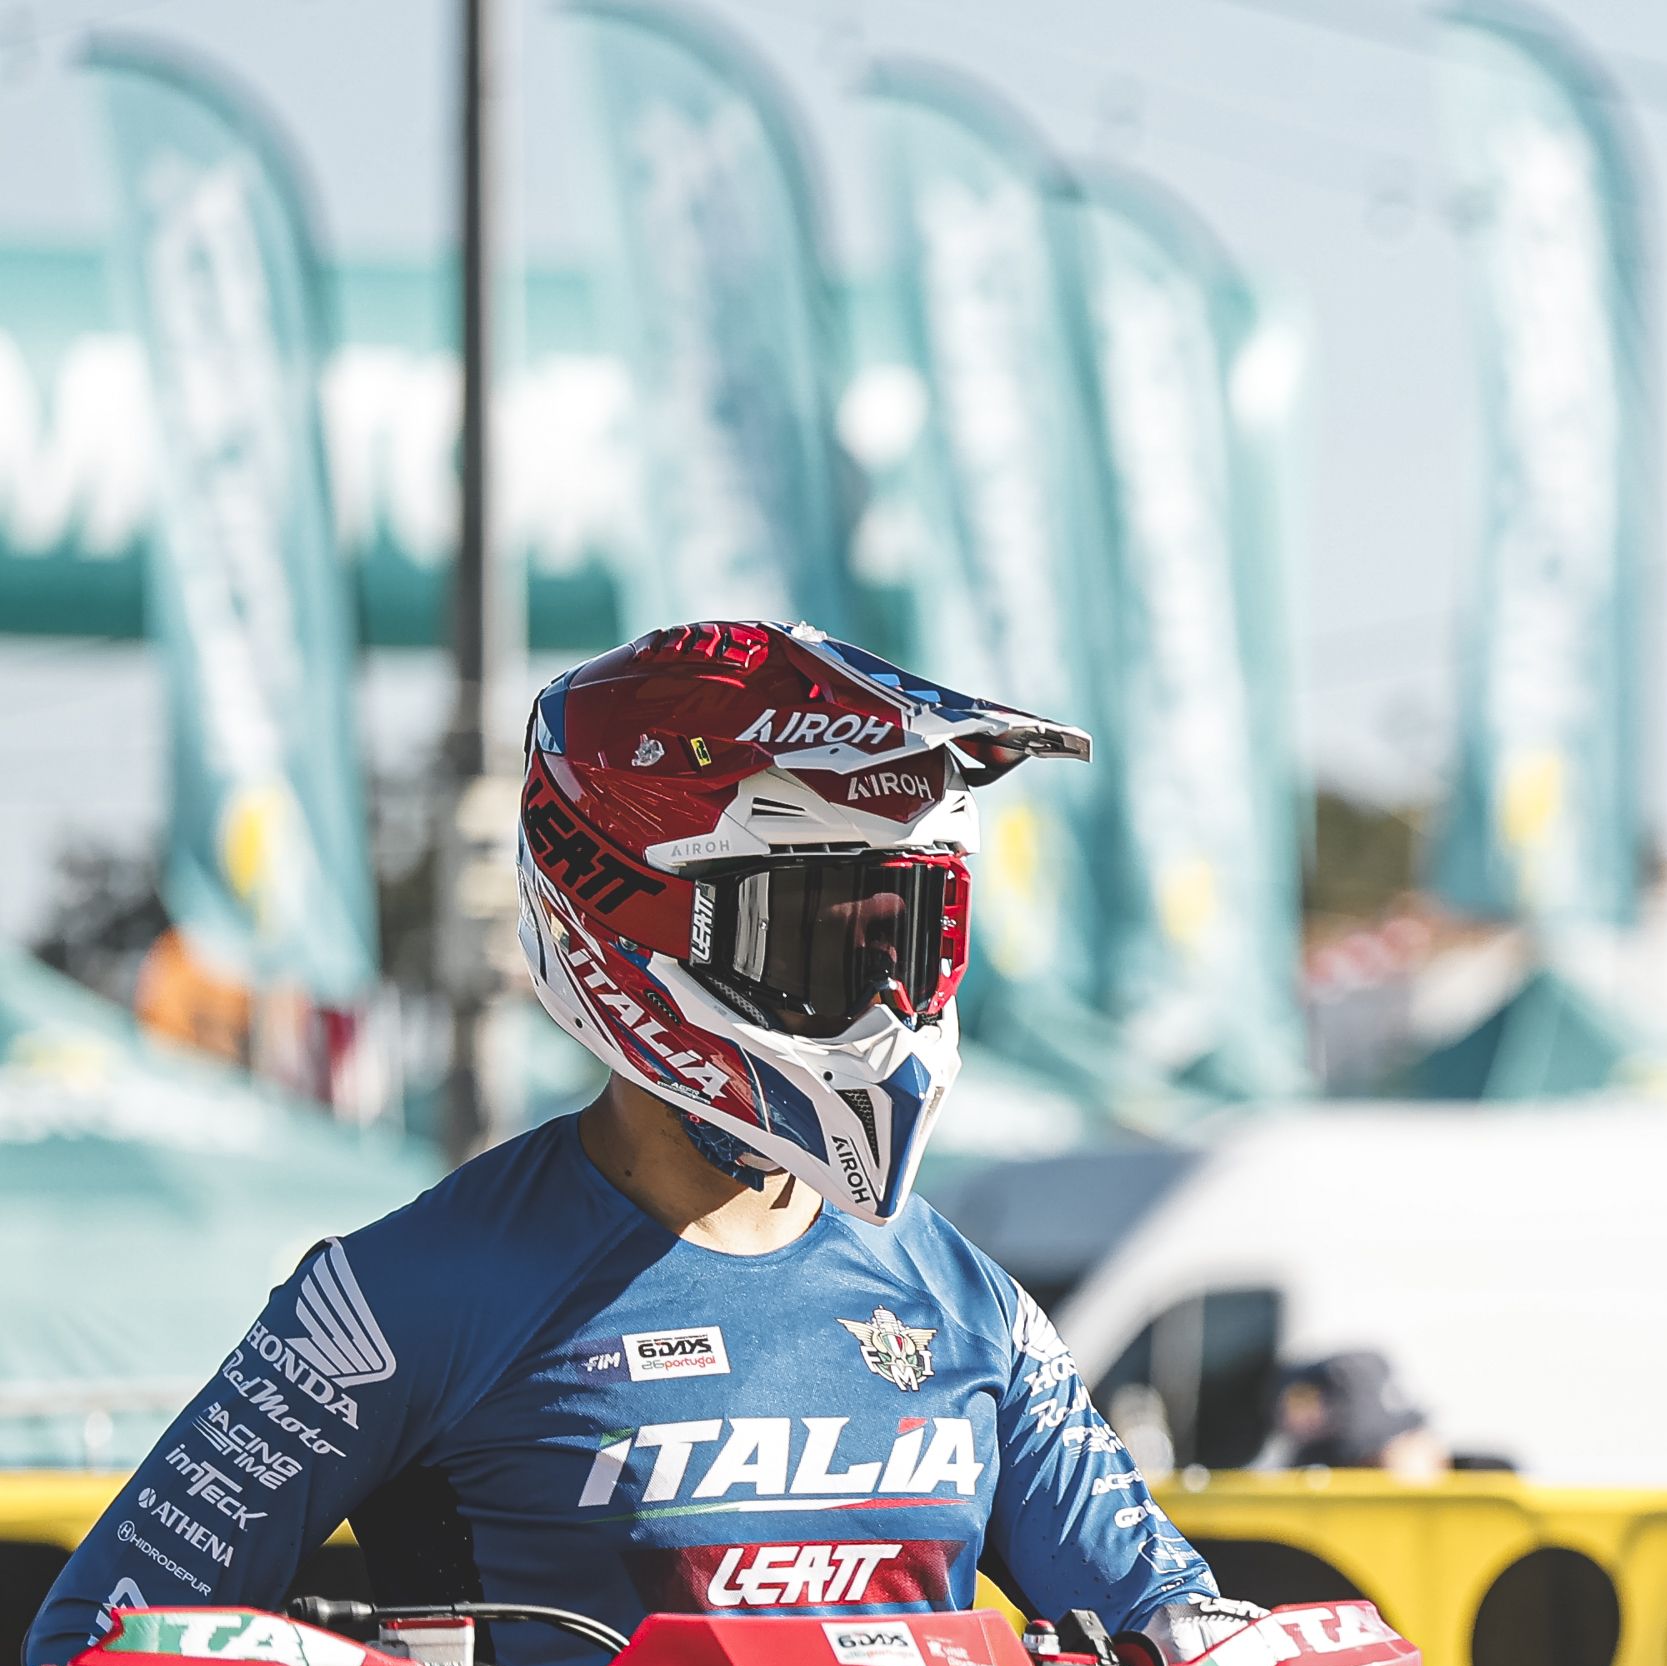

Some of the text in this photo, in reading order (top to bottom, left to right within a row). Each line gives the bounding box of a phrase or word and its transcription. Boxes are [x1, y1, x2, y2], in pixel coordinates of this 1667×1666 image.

[736, 709, 896, 746] AIROH
[847, 772, 932, 801] AIROH
[671, 840, 730, 858] AIROH
[565, 948, 731, 1101] ITALIA
[832, 1134, 870, 1204] AIROH
[246, 1321, 361, 1430] HONDA
[638, 1337, 713, 1359] 6DAYS
[203, 1402, 303, 1477] RACING
[219, 1441, 291, 1492] TIME
[578, 1416, 985, 1508] ITALIA
[131, 1532, 214, 1597] HIDRODEPUR
[149, 1498, 234, 1569] ATHENA
[706, 1543, 904, 1607] LEATT
